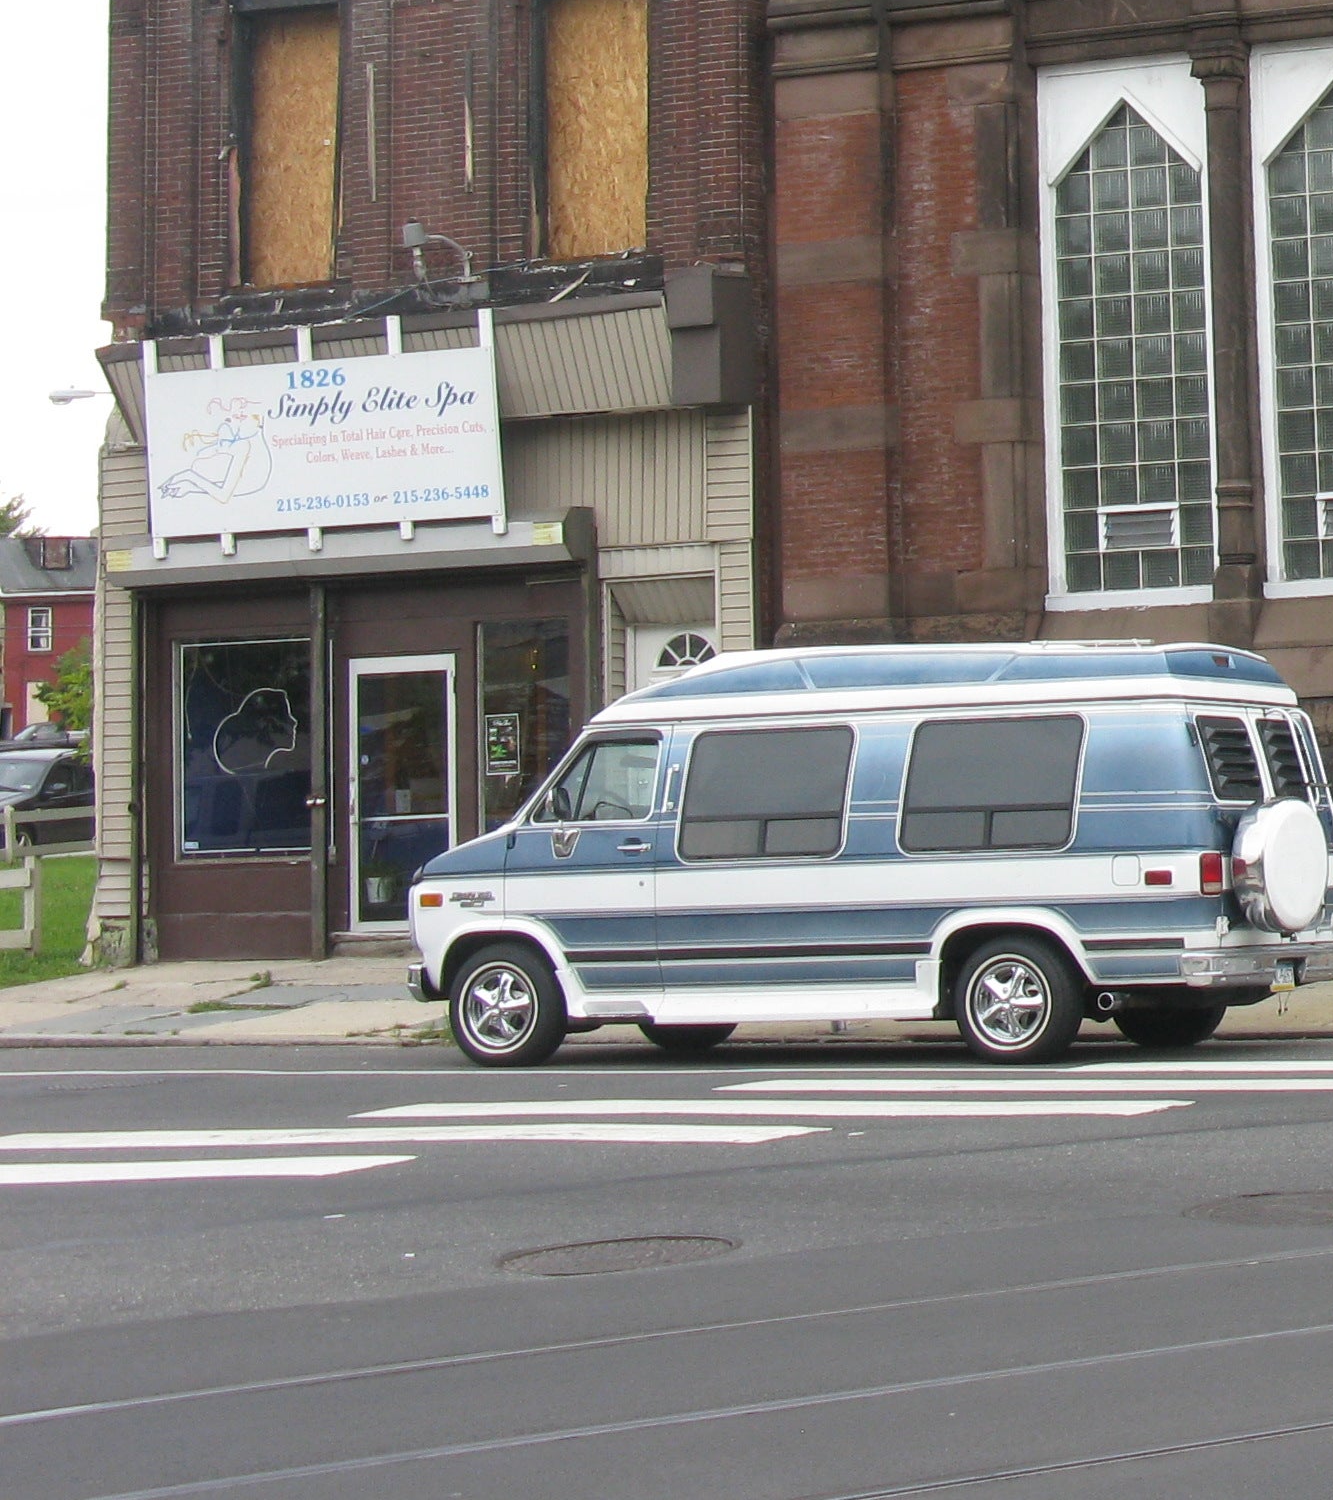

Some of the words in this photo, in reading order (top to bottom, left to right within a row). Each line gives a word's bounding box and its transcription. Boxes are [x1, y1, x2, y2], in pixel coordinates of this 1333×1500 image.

[286, 367, 347, 390] 1826
[267, 390, 354, 427] Simply
[361, 386, 419, 413] Elite
[424, 381, 479, 417] Spa
[271, 430, 328, 449] Specializing
[329, 431, 339, 443] In
[340, 428, 364, 443] Total
[366, 427, 387, 441] Hair
[388, 425, 414, 440] Care,
[415, 422, 460, 437] Precision
[305, 451, 339, 464] Colors,
[340, 448, 374, 462] Weave,
[375, 443, 408, 459] Lashes
[409, 443, 419, 456] &
[276, 492, 371, 513] 215-236-0153
[373, 495, 389, 504] or
[392, 484, 491, 505] 215-236-5448
